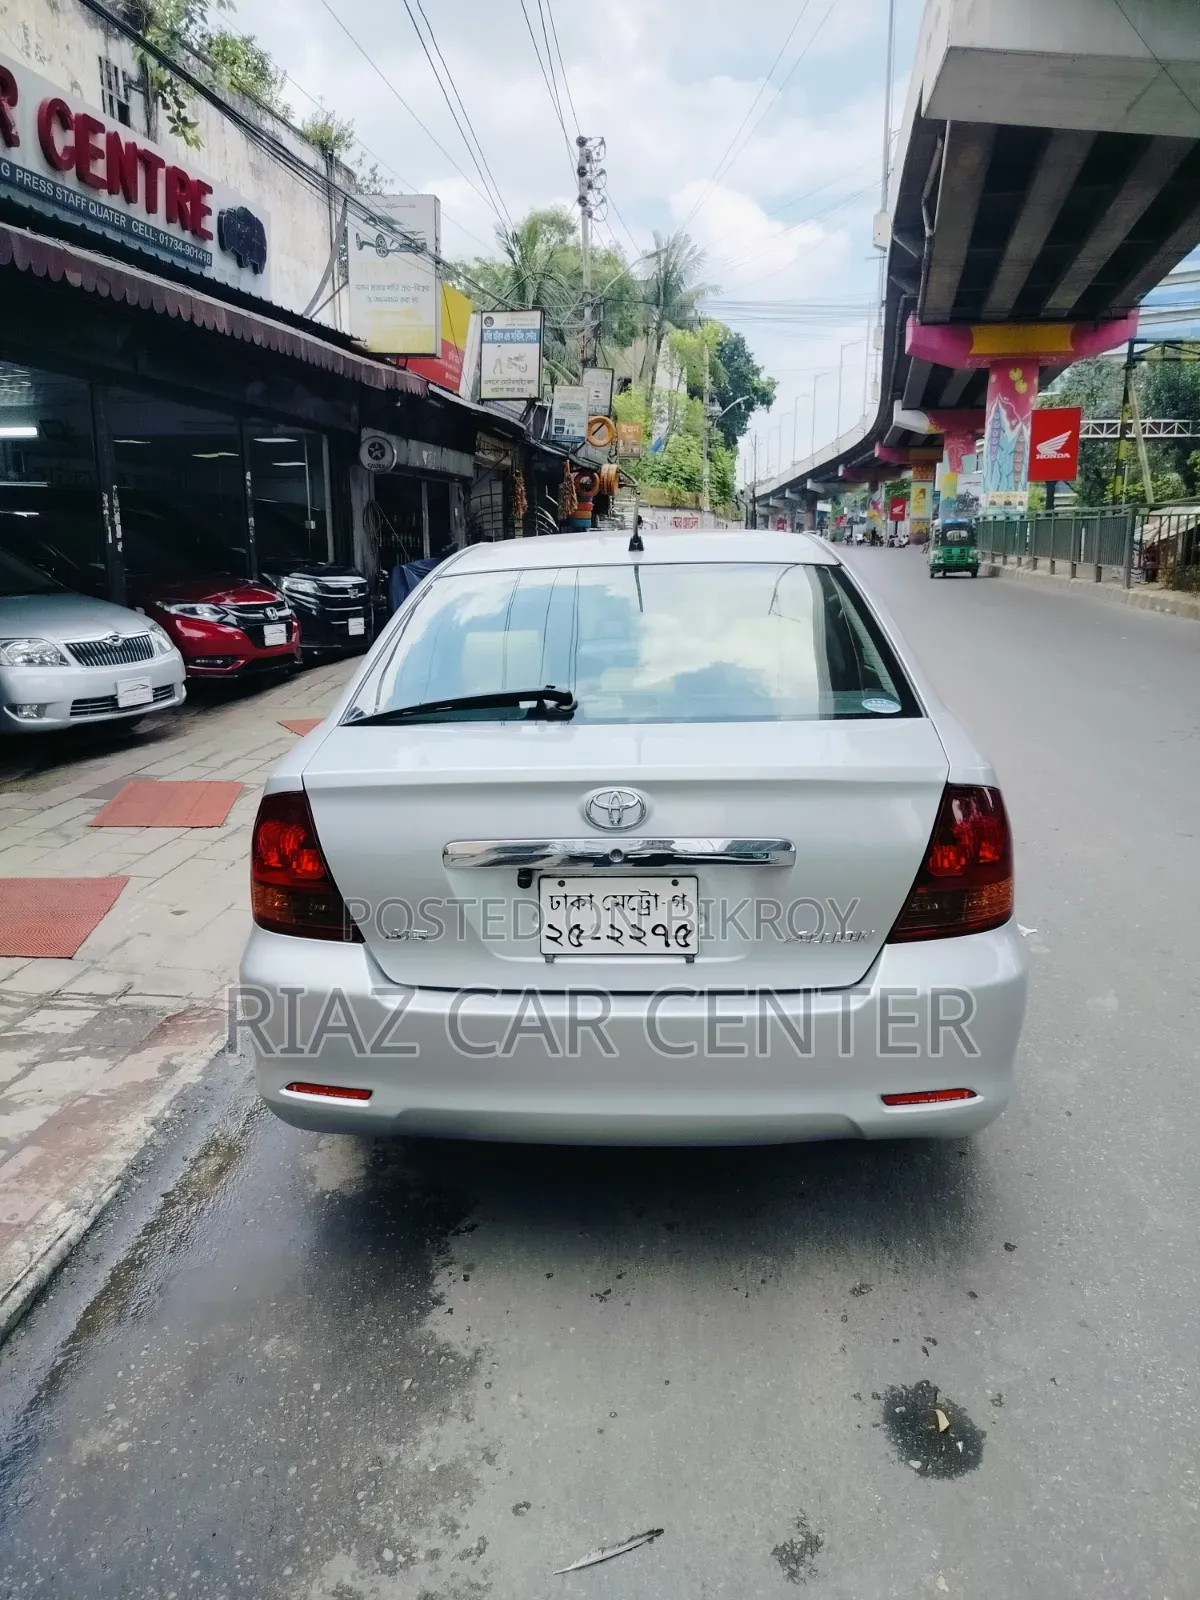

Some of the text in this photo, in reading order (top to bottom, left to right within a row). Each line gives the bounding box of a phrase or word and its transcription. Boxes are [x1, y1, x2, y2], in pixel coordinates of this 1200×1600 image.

[37, 97, 214, 242] CENTRE
[15, 168, 54, 197] PRESS
[56, 187, 87, 210] STAFF
[89, 201, 127, 229] QUATER
[131, 220, 158, 243] CELL:
[159, 230, 212, 266] 01734-901418
[1036, 452, 1071, 460] HONDA
[549, 893, 594, 911] ঢাকা
